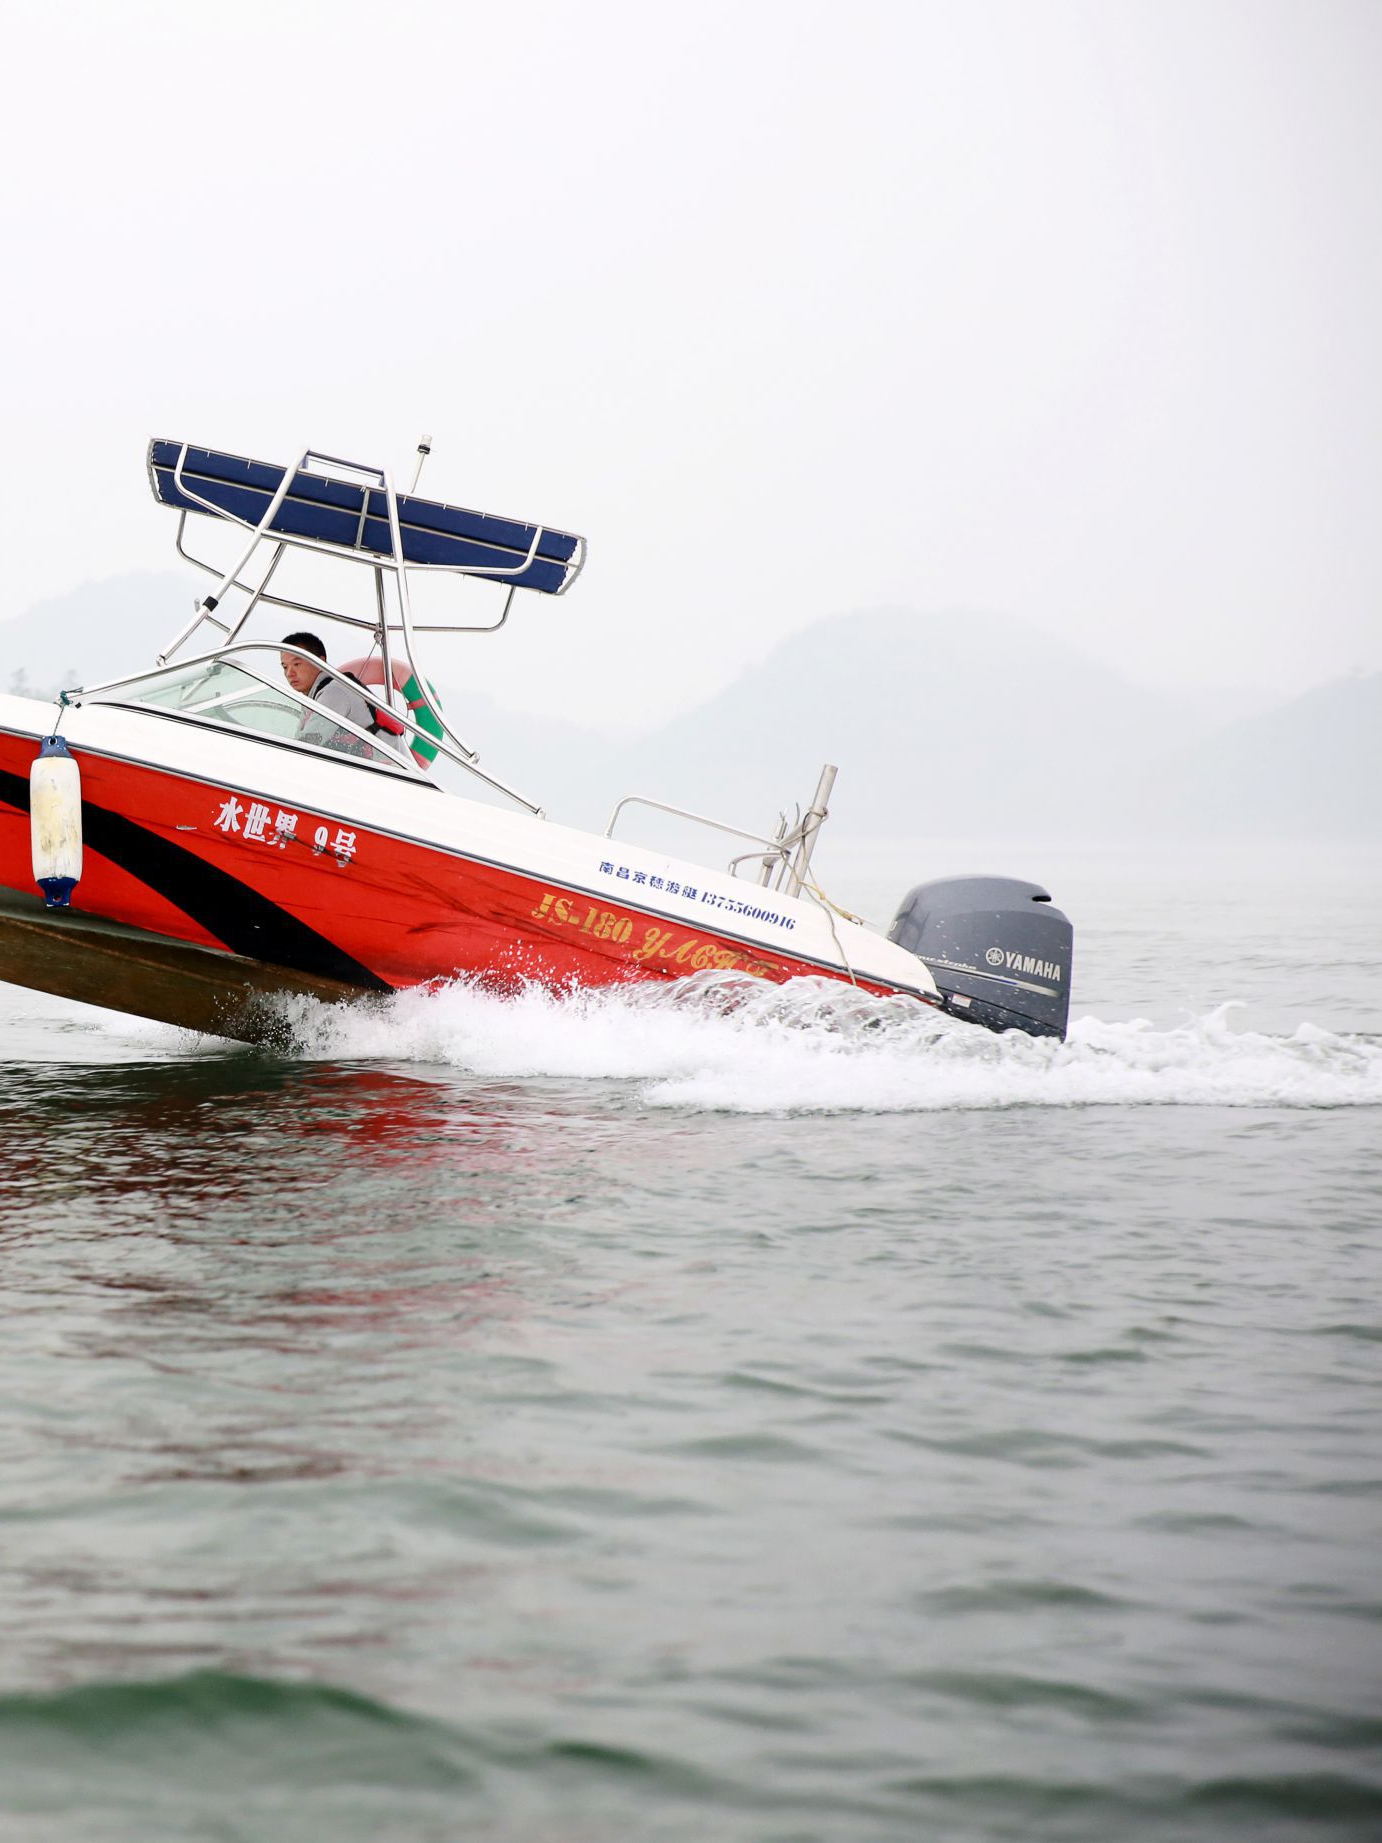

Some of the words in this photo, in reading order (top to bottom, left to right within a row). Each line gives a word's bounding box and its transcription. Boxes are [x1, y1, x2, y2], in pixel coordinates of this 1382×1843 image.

[213, 796, 298, 849] 水世界
[531, 893, 633, 943] JS-180
[700, 891, 796, 930] 13755600916
[1006, 951, 1061, 982] YAMAHA
